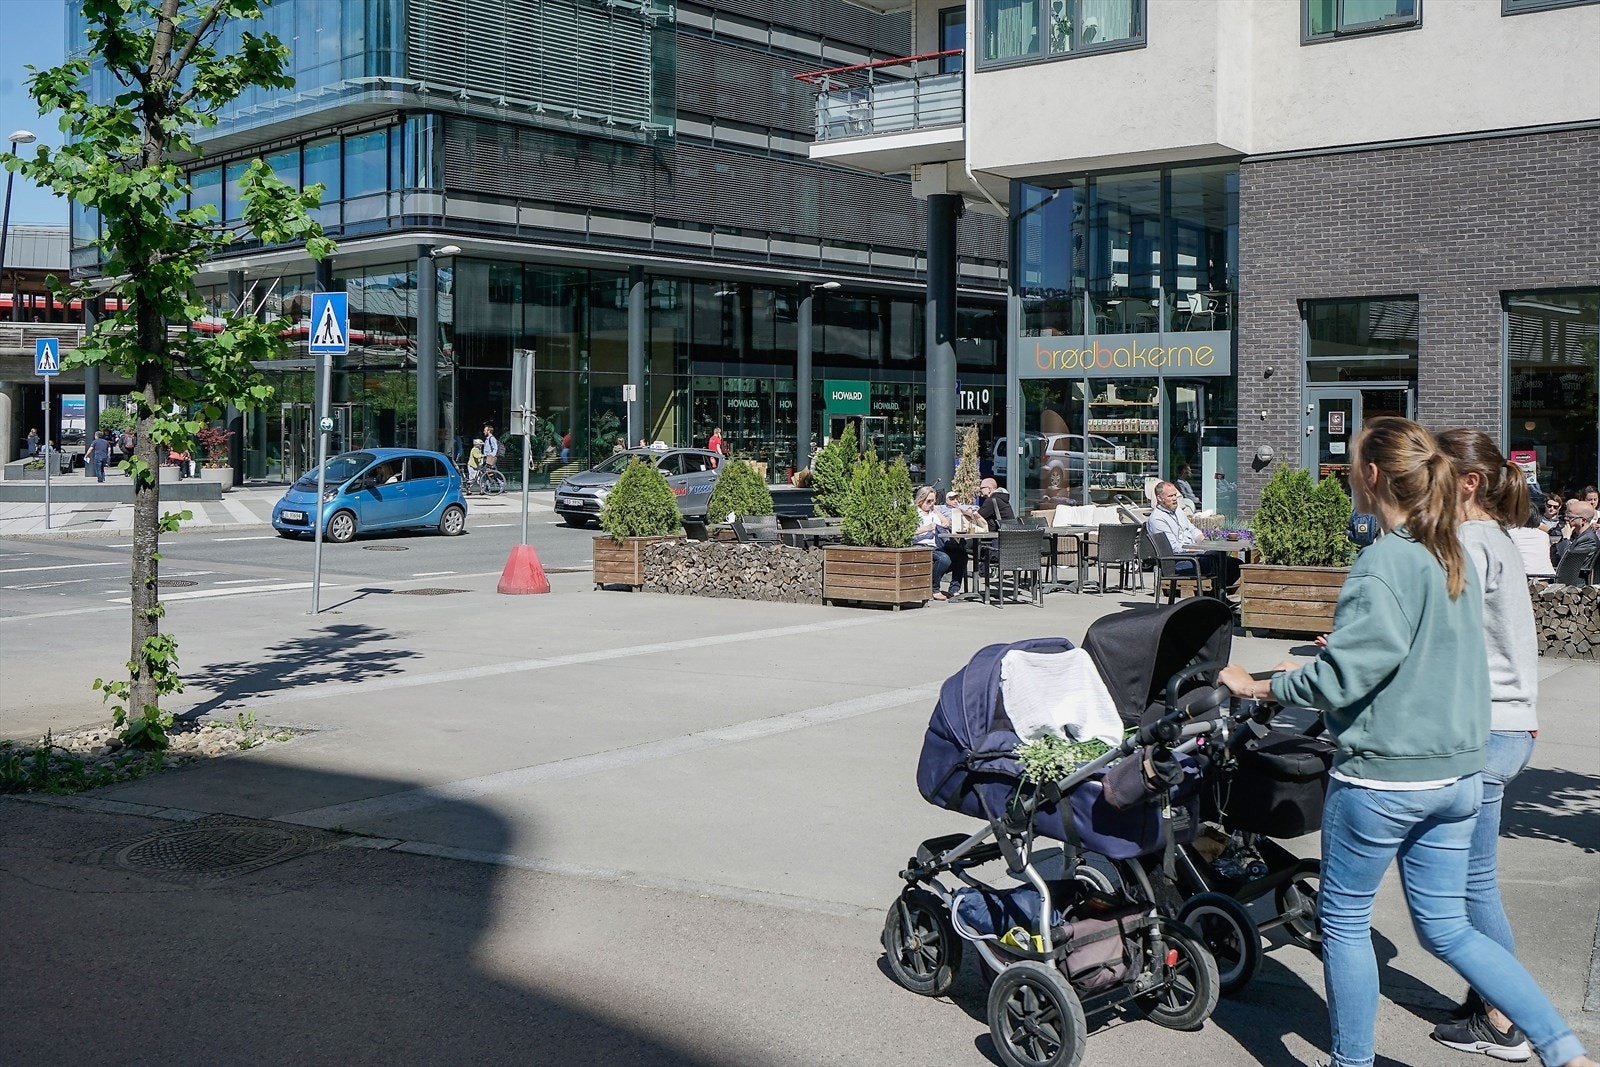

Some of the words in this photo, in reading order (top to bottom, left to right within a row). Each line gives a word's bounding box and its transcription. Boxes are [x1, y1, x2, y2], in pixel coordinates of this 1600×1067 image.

[1036, 340, 1215, 369] brødbakerne
[832, 391, 863, 401] HOWARD
[960, 389, 989, 410] TRIO
